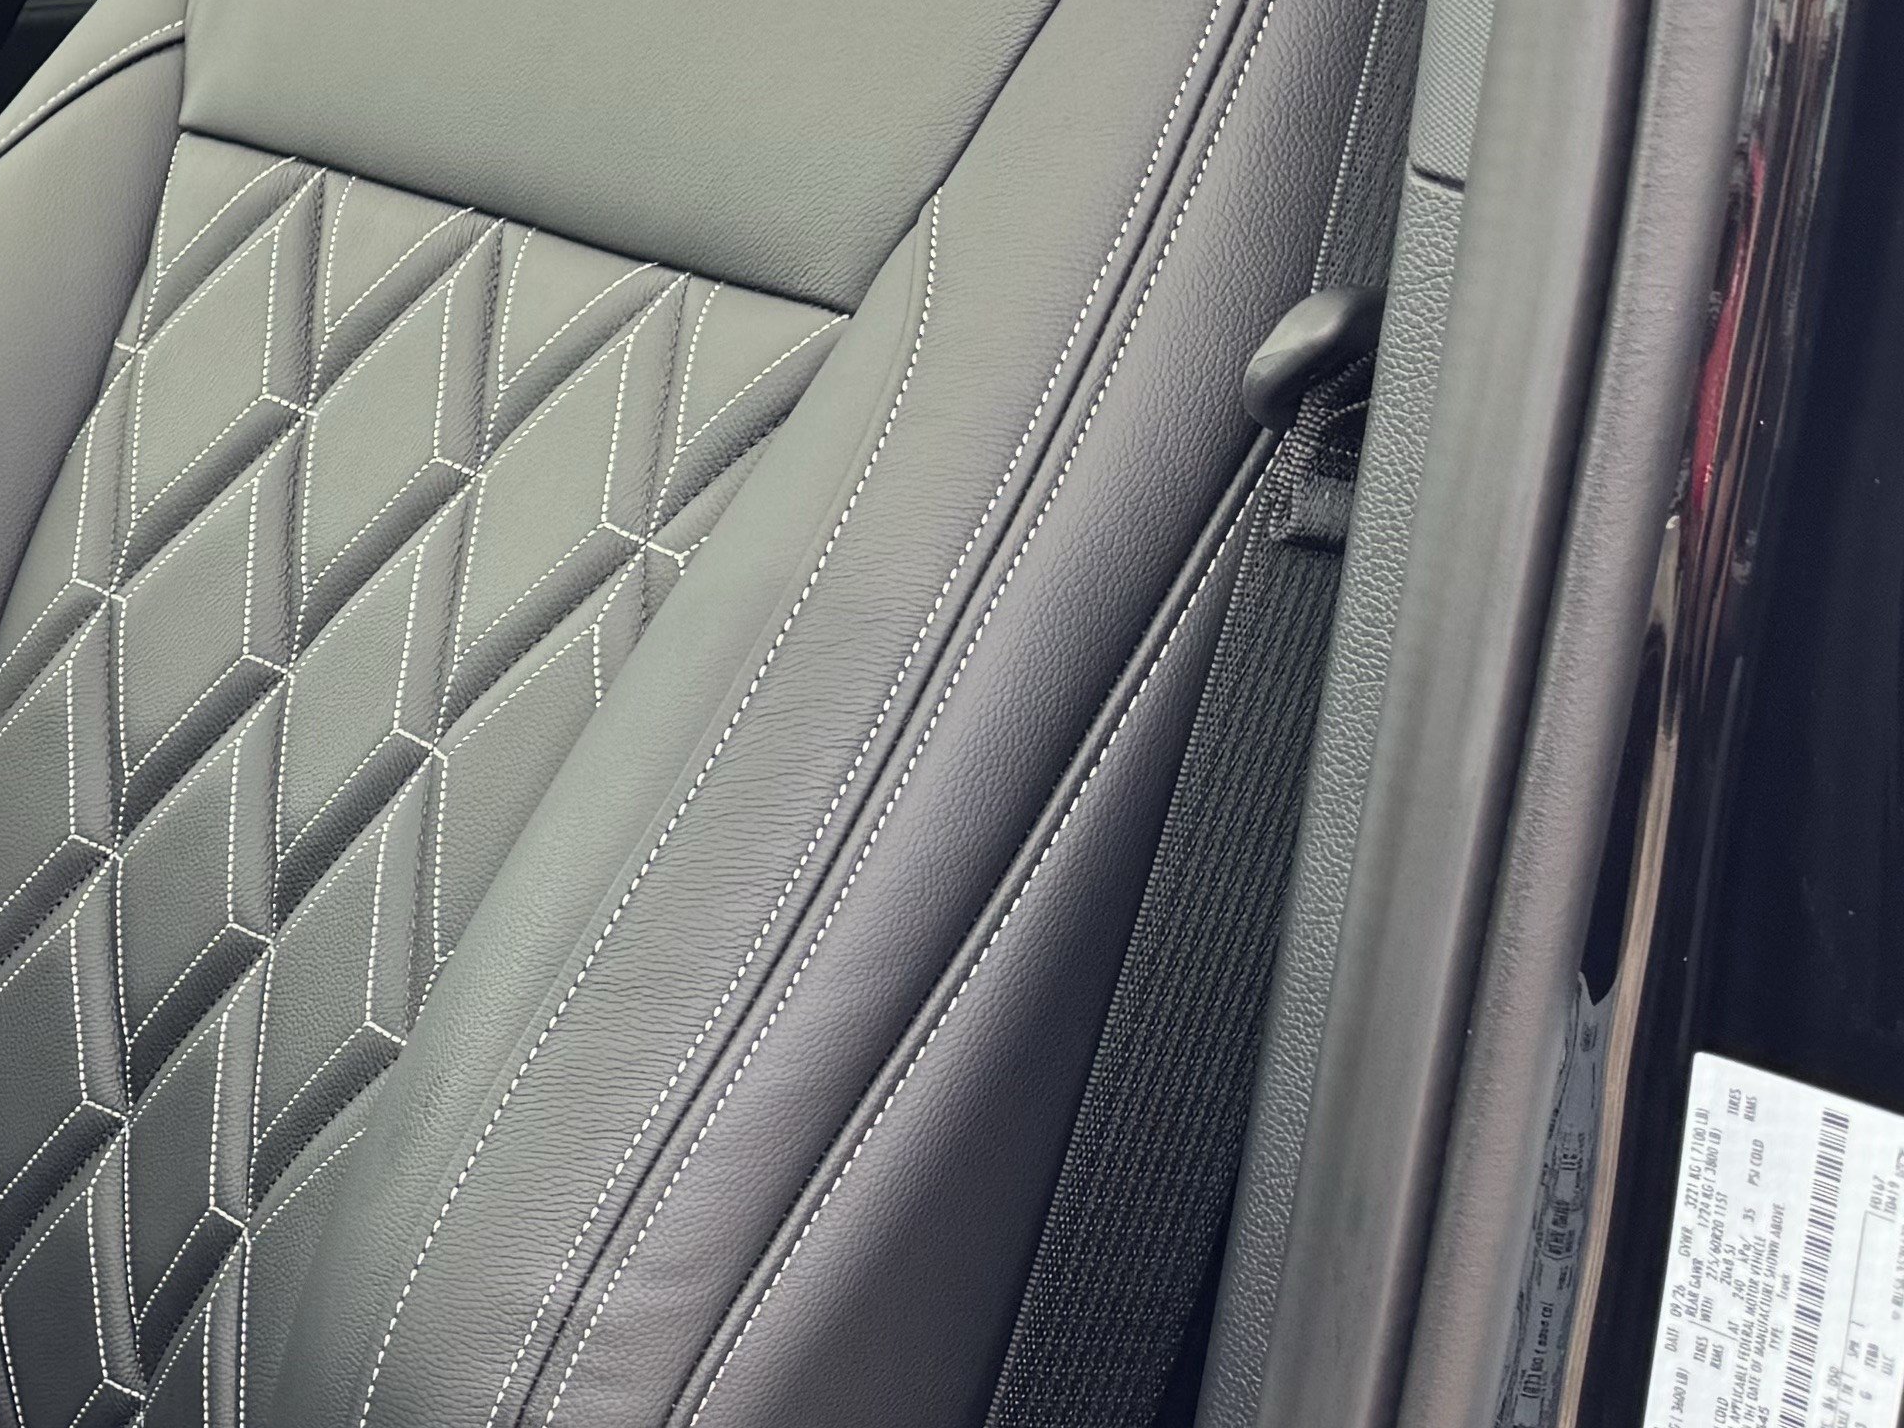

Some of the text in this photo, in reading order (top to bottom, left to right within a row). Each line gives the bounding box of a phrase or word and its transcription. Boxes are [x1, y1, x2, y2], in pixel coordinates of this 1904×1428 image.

[1684, 1290, 1700, 1318] REAR
[1701, 1183, 1715, 1201] KG
[1750, 1235, 1767, 1276] VEHICLE
[1762, 1239, 1781, 1280] SHOWN
[1713, 1396, 1729, 1425] COLD
[1727, 1320, 1740, 1336] AT
[1749, 1138, 1765, 1167] COLD
[1744, 1277, 1760, 1317] MOTOR
[1699, 1296, 1714, 1323] WITH
[1753, 1281, 1775, 1358] MANUFACTURE
[1692, 1335, 1709, 1364] TIRES
[1736, 1318, 1756, 1362] FEDERAL
[1749, 1358, 1763, 1374] OF
[1728, 1363, 1748, 1424] APPLICABLE
[1745, 1374, 1762, 1402] DATE
[1742, 1402, 1757, 1423] THE
